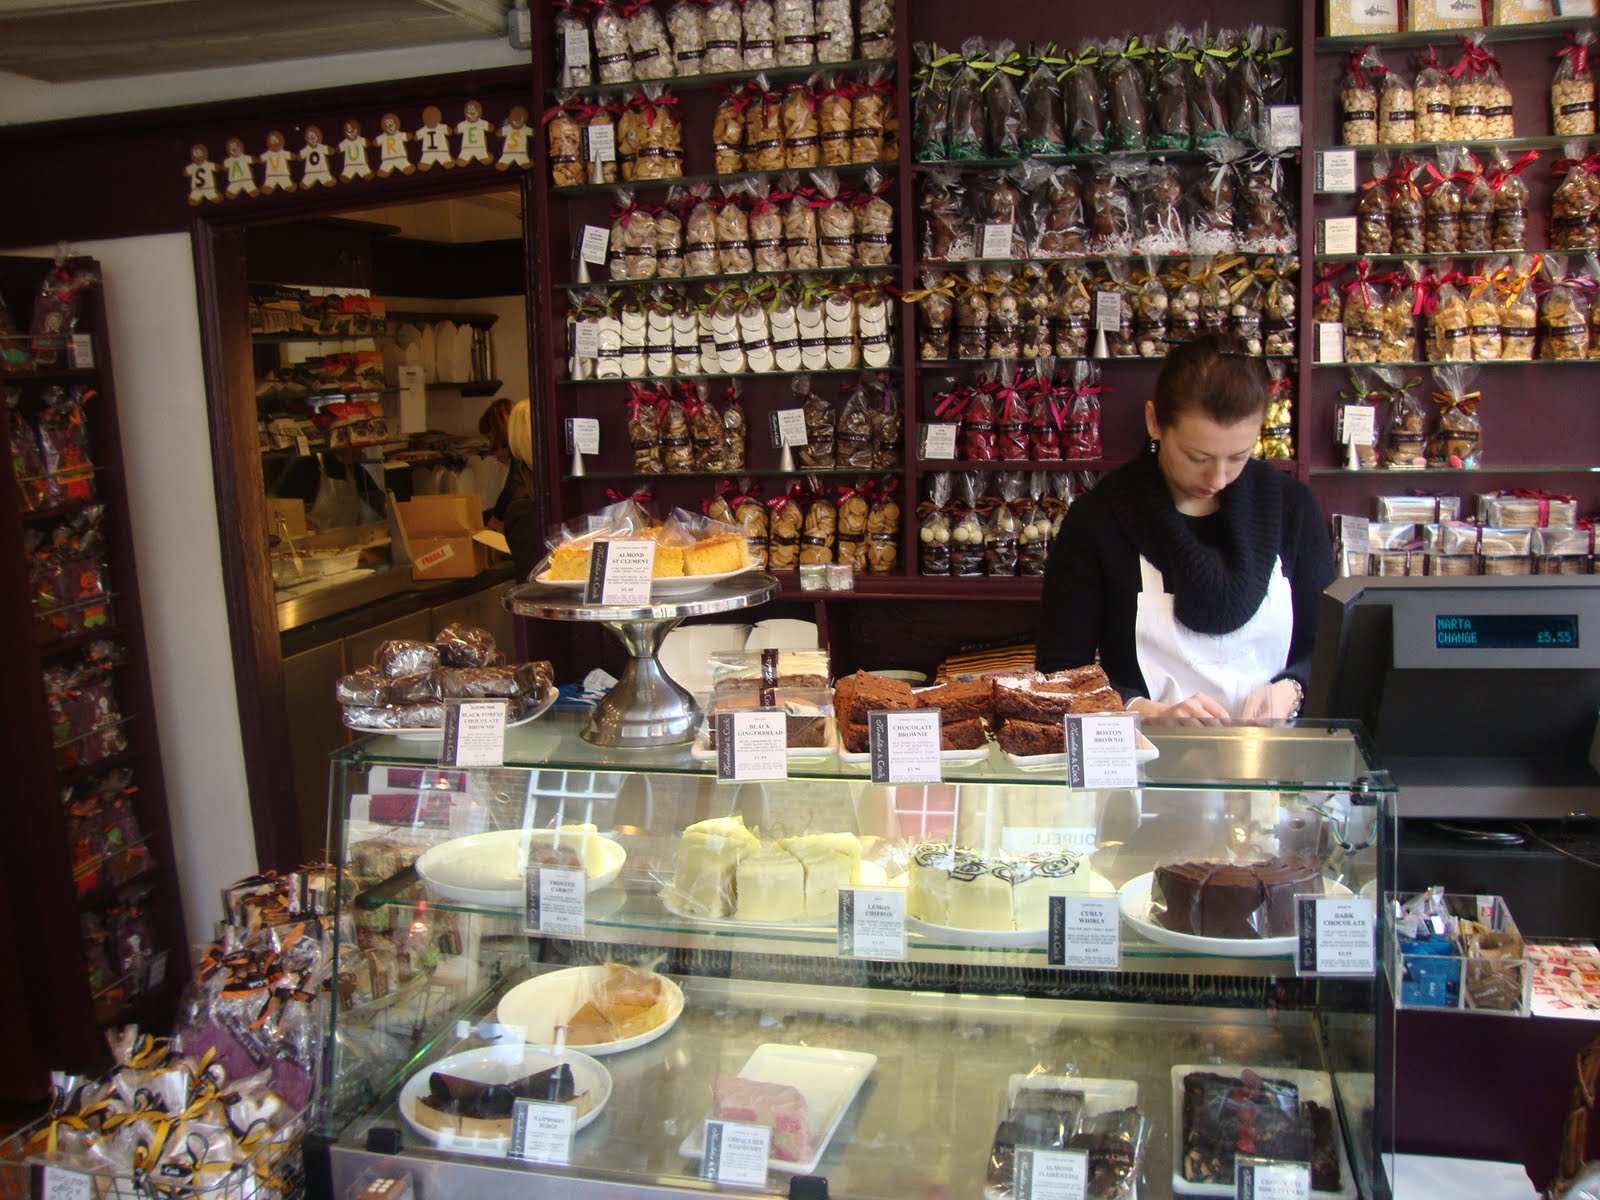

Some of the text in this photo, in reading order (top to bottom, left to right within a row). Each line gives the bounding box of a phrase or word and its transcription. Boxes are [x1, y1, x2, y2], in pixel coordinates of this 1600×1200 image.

[195, 126, 520, 188] SAVOURIES
[421, 549, 447, 566] FRAGILE
[592, 582, 601, 600] Cook
[1437, 618, 1471, 630] MARTA
[1437, 631, 1572, 644] CHANGE £5.55
[722, 717, 731, 736] Cook
[877, 760, 885, 779] Cook
[1071, 764, 1081, 784] Cook
[1054, 941, 1062, 961] Cook
[533, 1116, 565, 1124] RASPBERRY
[728, 1144, 763, 1152] RASPBERRY
[1111, 1153, 1130, 1162] Cook
[1038, 1172, 1079, 1180] FLORENTINE
